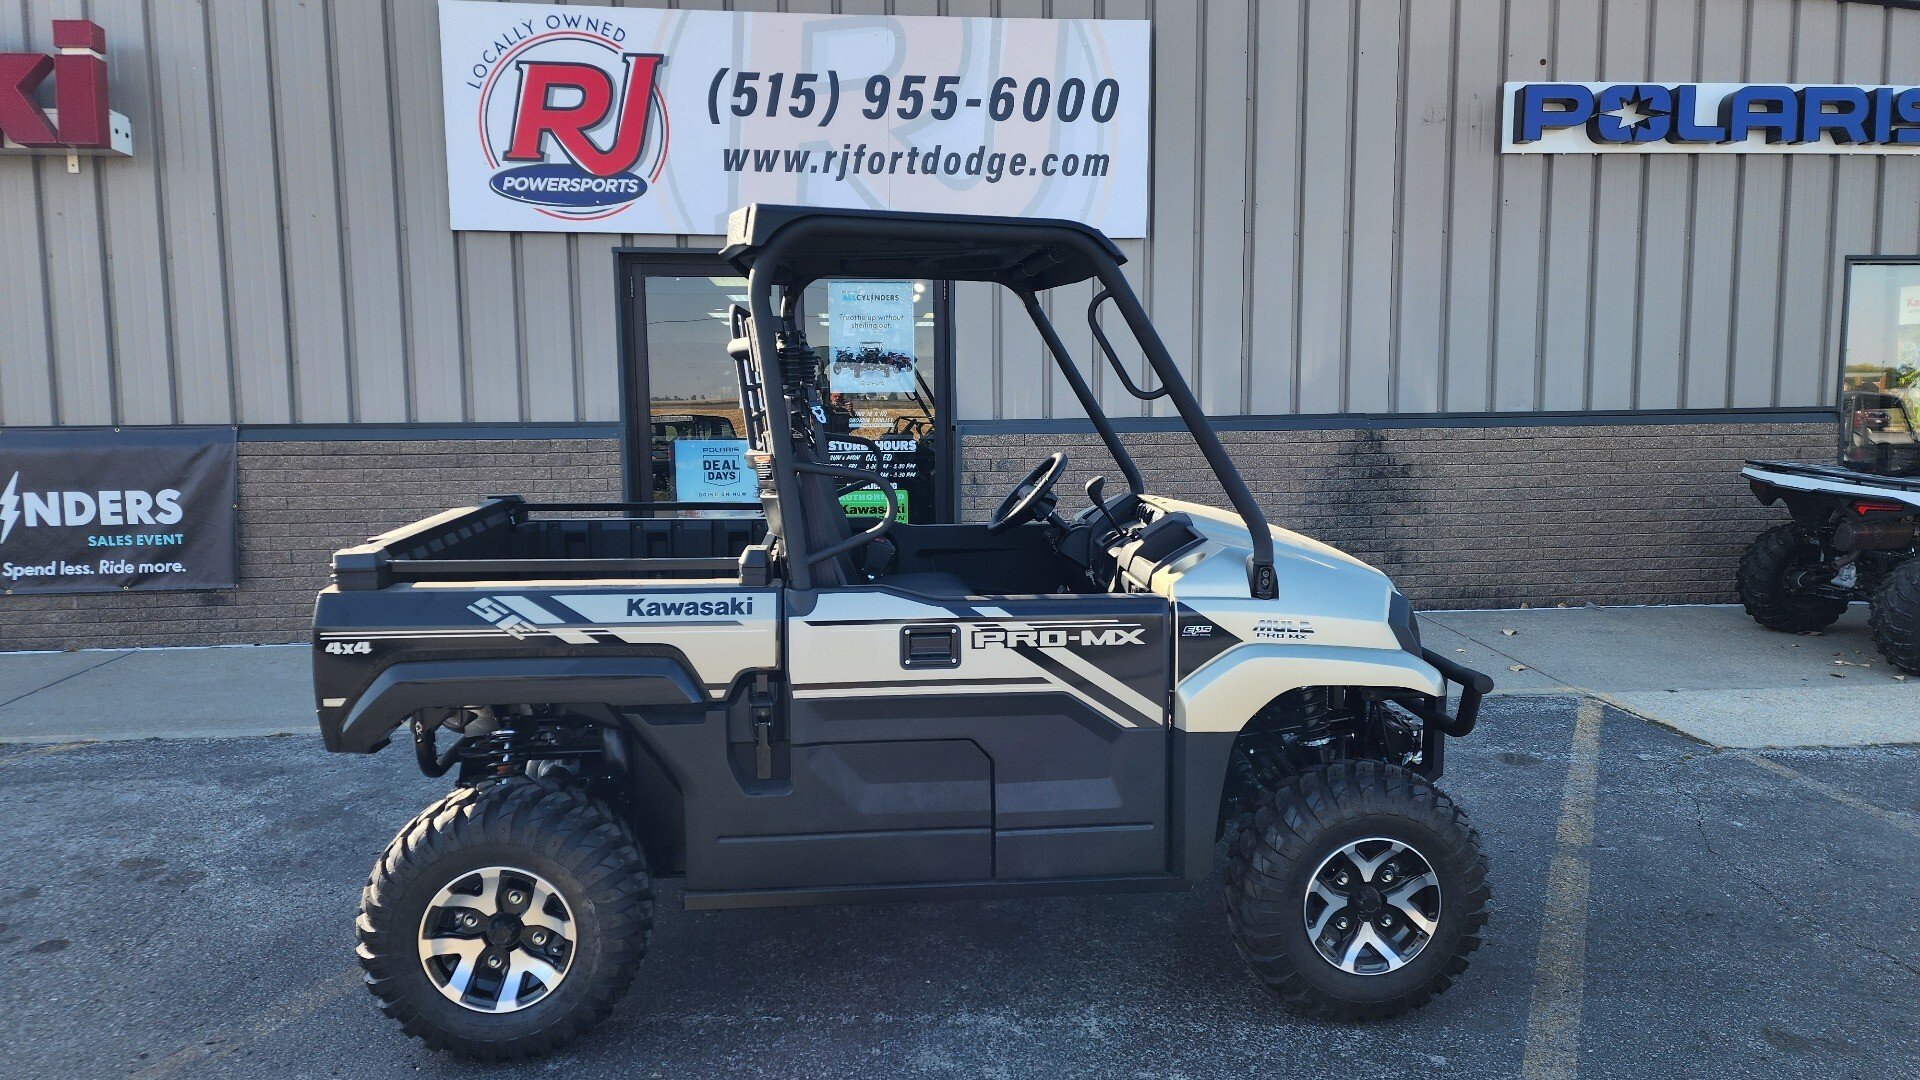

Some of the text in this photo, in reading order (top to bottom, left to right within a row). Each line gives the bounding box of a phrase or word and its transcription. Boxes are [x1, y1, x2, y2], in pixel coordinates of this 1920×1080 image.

[467, 14, 626, 90] LOCALLY OWNED
[707, 67, 1120, 127] (515) 955-6000
[501, 53, 666, 176] RJ
[723, 143, 1110, 183] www.rjfortdodge.com
[502, 176, 638, 193] POWERSPORTS
[702, 460, 741, 471] DEAL
[708, 471, 736, 480] DAYS
[88, 533, 184, 547] SALES EVENT
[2, 559, 187, 580] Spend less. Ride more.
[626, 596, 753, 617] Kawasaki
[1252, 619, 1315, 633] MULE
[324, 641, 374, 656] 4x4
[971, 628, 1146, 650] PRO-MX
